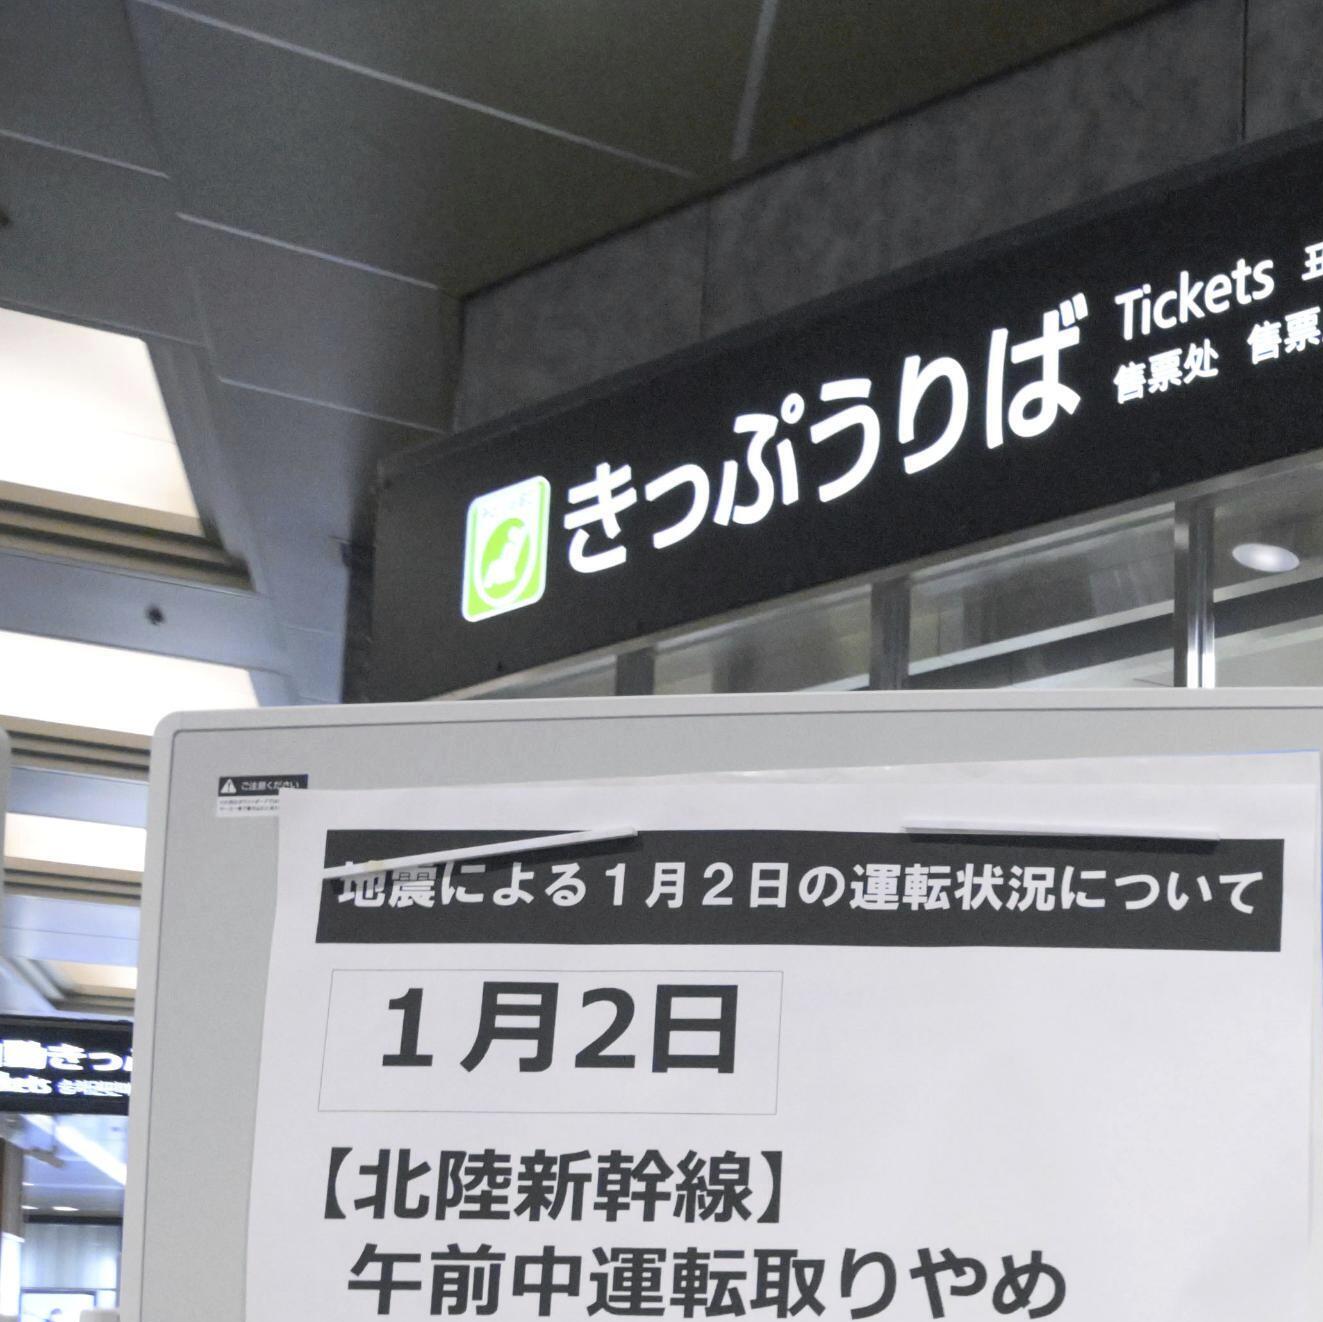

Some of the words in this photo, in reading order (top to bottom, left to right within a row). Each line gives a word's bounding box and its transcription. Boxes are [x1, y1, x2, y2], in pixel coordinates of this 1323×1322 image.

[1114, 258, 1275, 340] Tickets
[1112, 338, 1219, 404] 售票处
[564, 292, 1089, 574] きっぷうりば
[336, 858, 1265, 915] 地震による1月2日の運転状況について
[381, 980, 739, 1074] 1月2日
[324, 1146, 783, 1224] 【北陸新幹線】
[347, 1242, 1066, 1320] 午前中運転取りやめ
